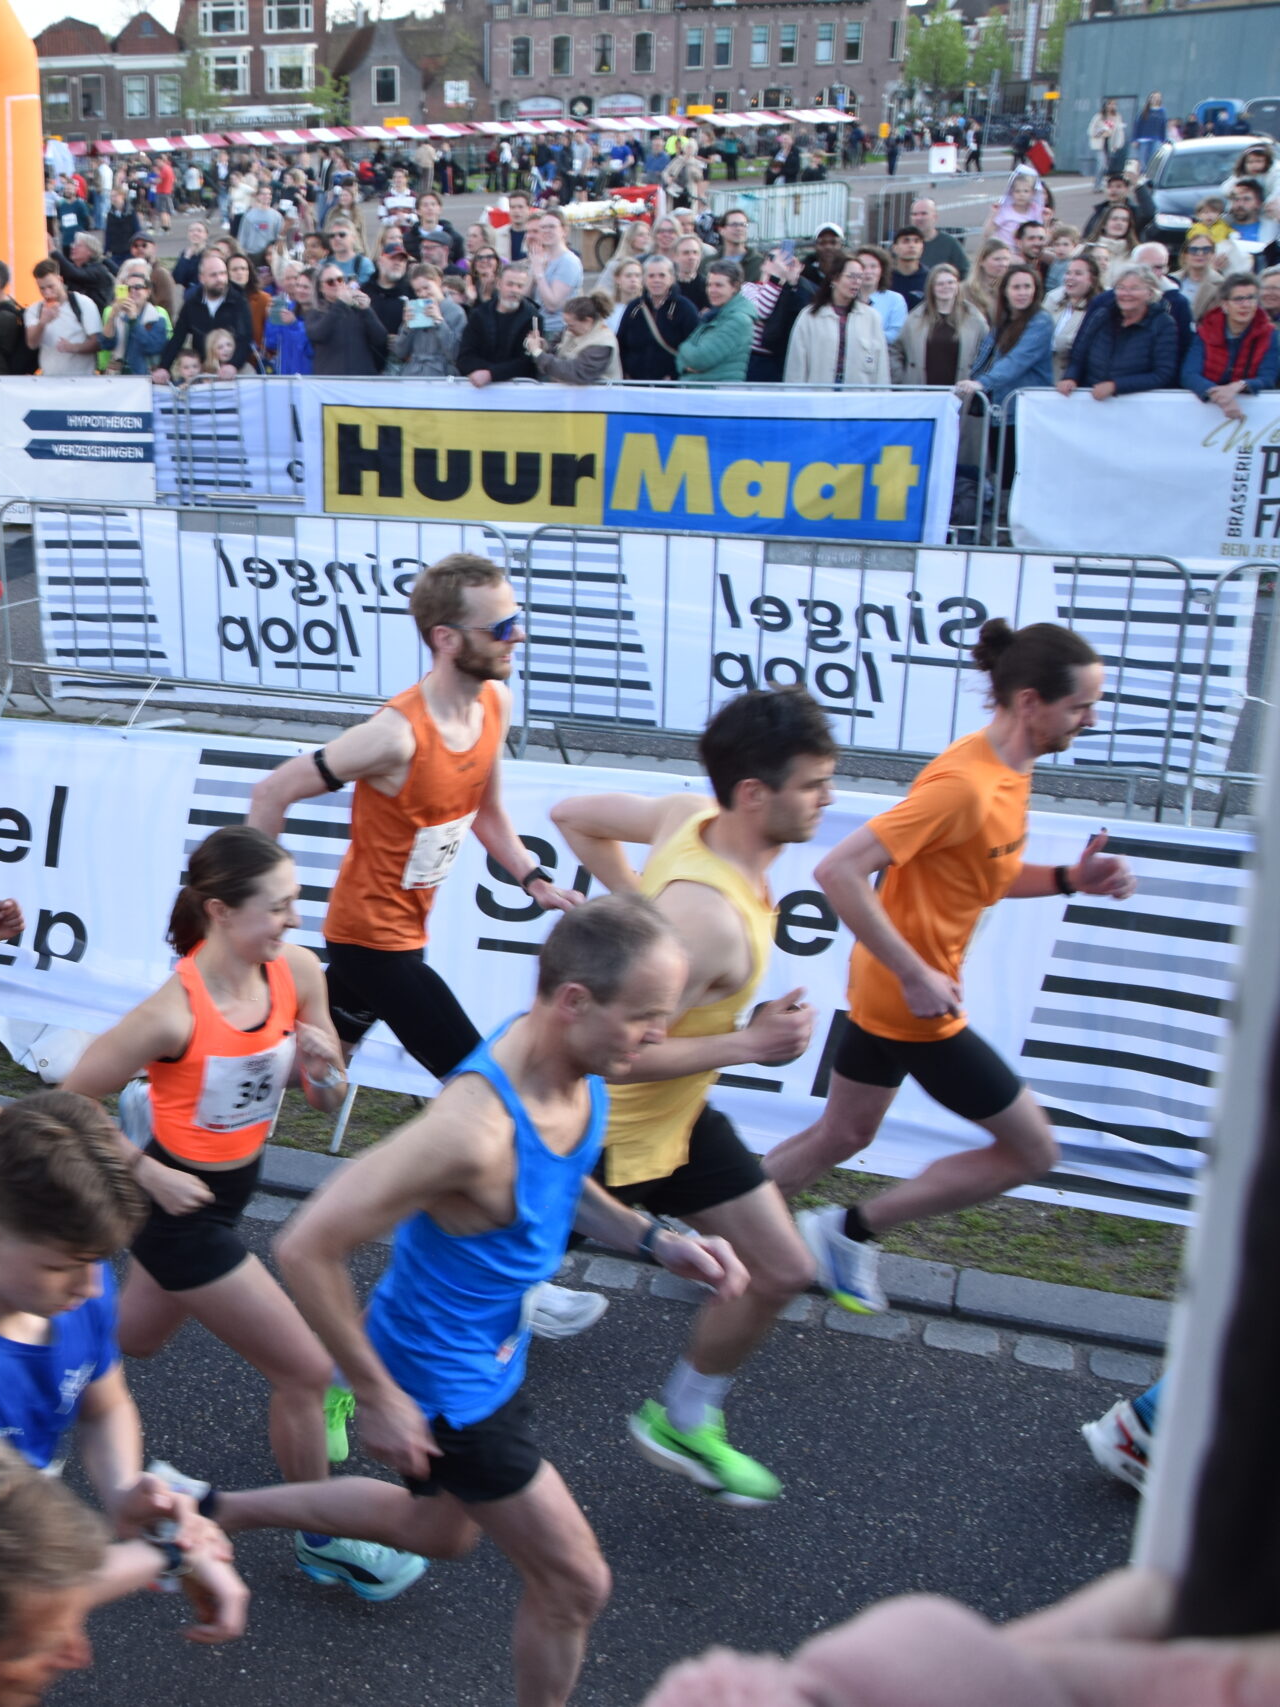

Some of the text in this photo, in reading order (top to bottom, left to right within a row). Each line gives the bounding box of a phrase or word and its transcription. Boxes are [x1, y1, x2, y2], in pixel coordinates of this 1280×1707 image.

[67, 414, 142, 429] HYPOTHEKEN
[51, 443, 144, 459] VERZEKERINGEN
[1227, 444, 1254, 538] BRASSERIE
[1221, 542, 1249, 556] BEN
[233, 1074, 274, 1109] 36
